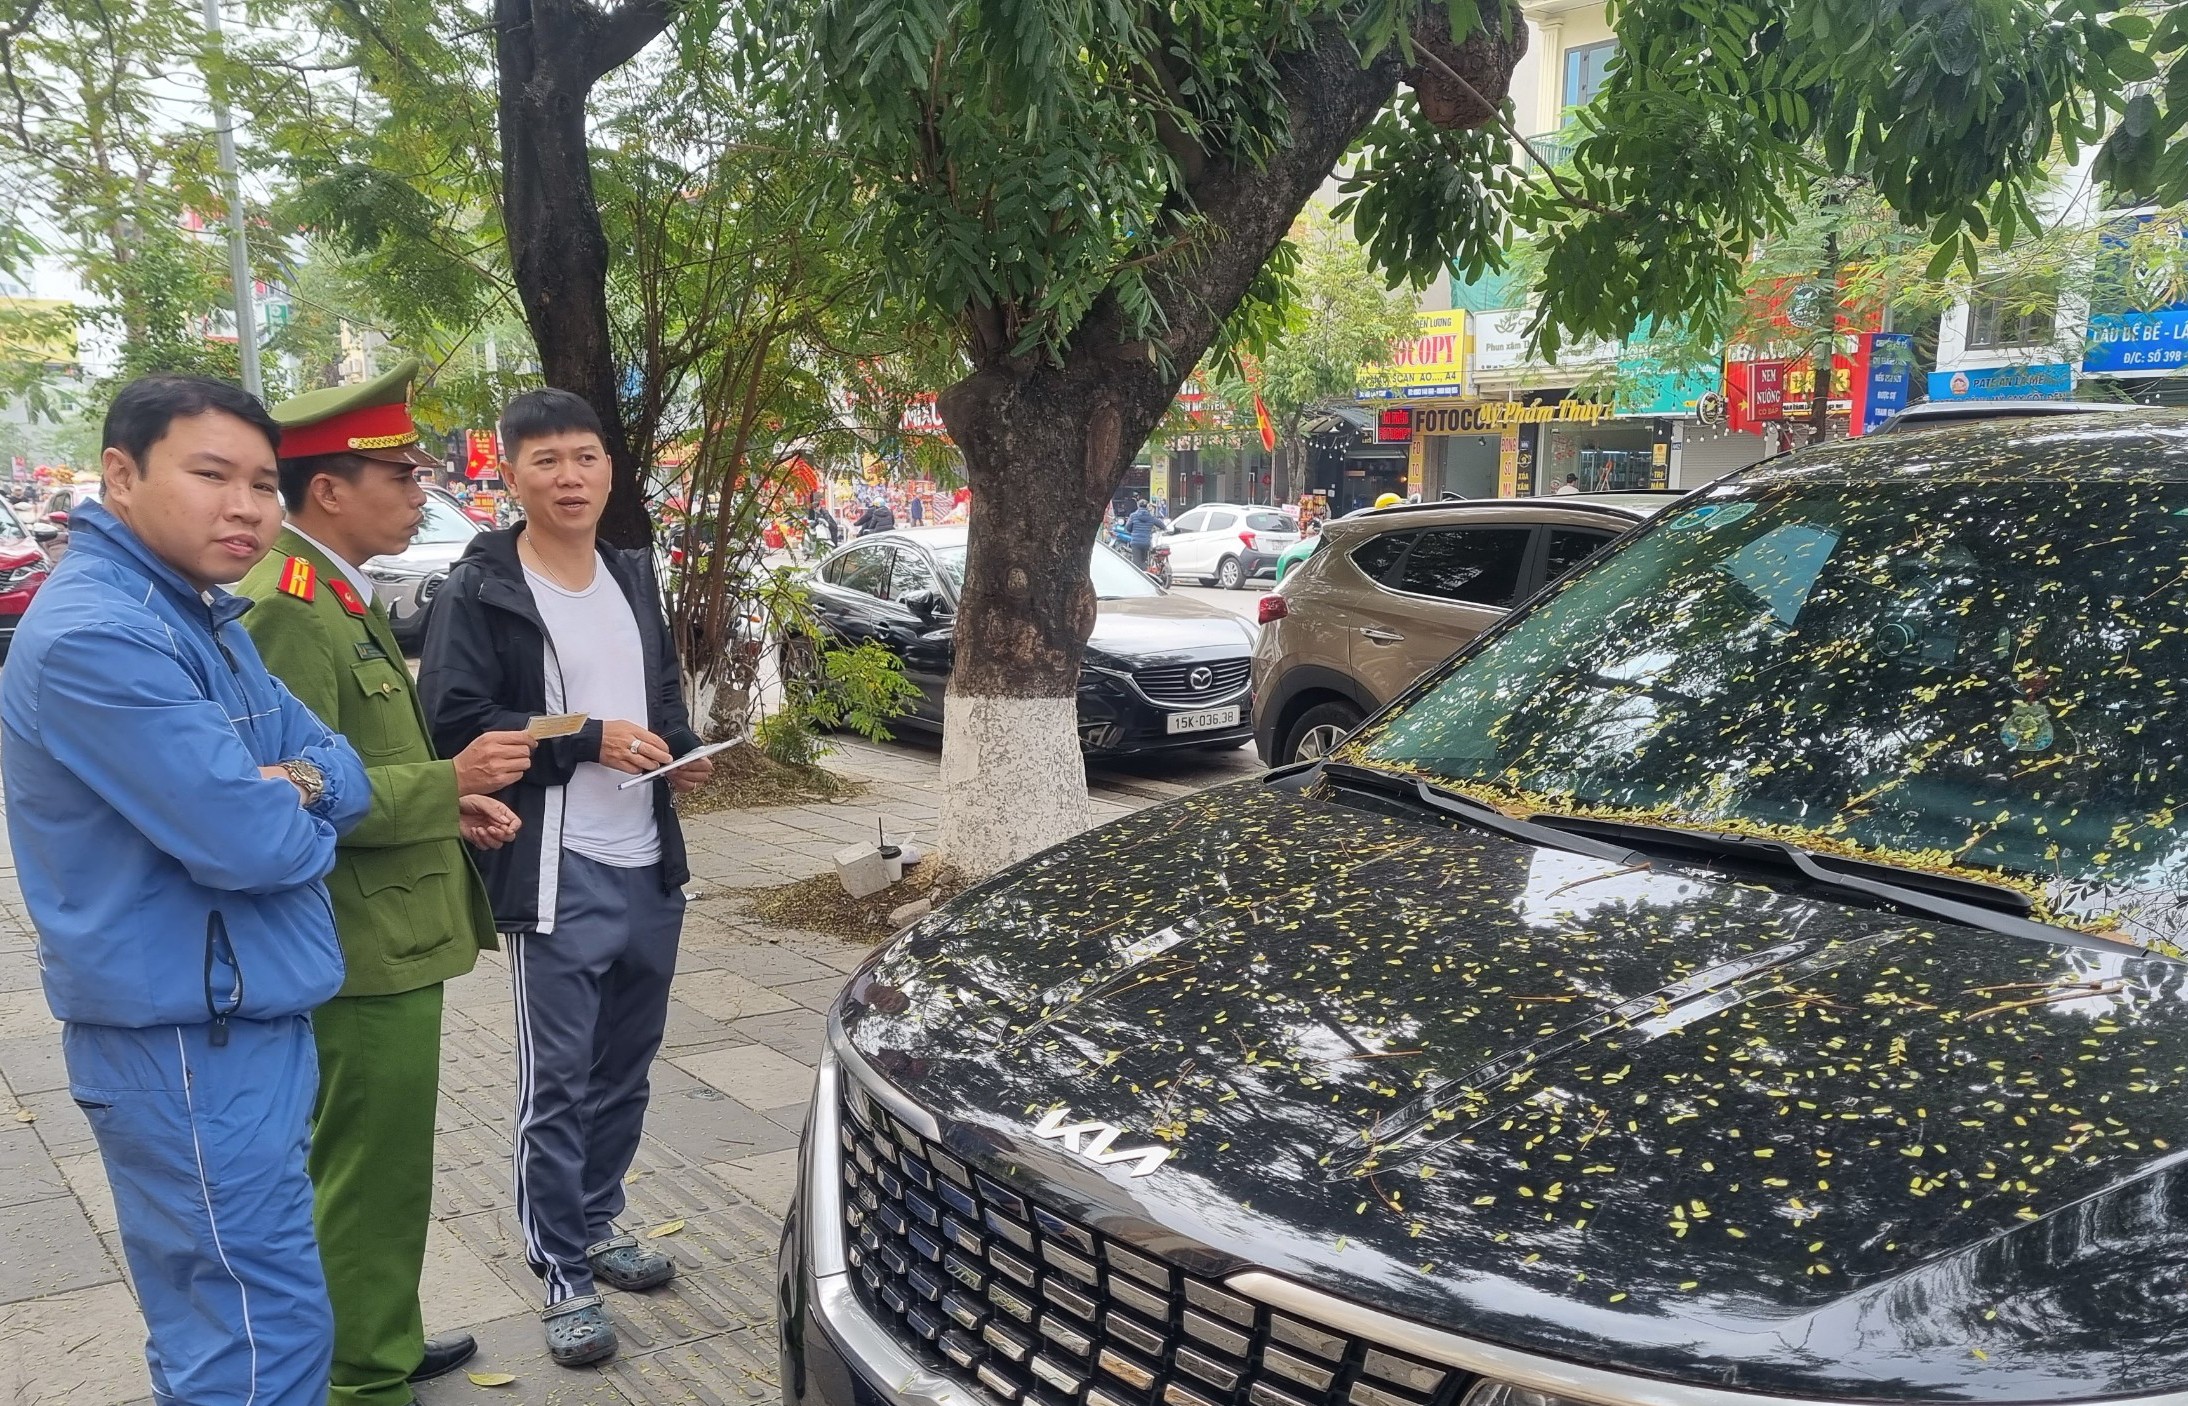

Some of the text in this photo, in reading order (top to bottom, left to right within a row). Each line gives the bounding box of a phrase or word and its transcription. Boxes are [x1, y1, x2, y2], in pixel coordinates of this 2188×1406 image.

[2163, 351, 2182, 362] 398
[1392, 373, 1415, 383] SCAN
[1444, 371, 1457, 380] A4
[1761, 369, 1776, 382] NEM
[1416, 408, 1507, 432] FOTOCO
[1175, 711, 1234, 730] 15K-036.38
[1032, 1107, 1172, 1178] KIA
